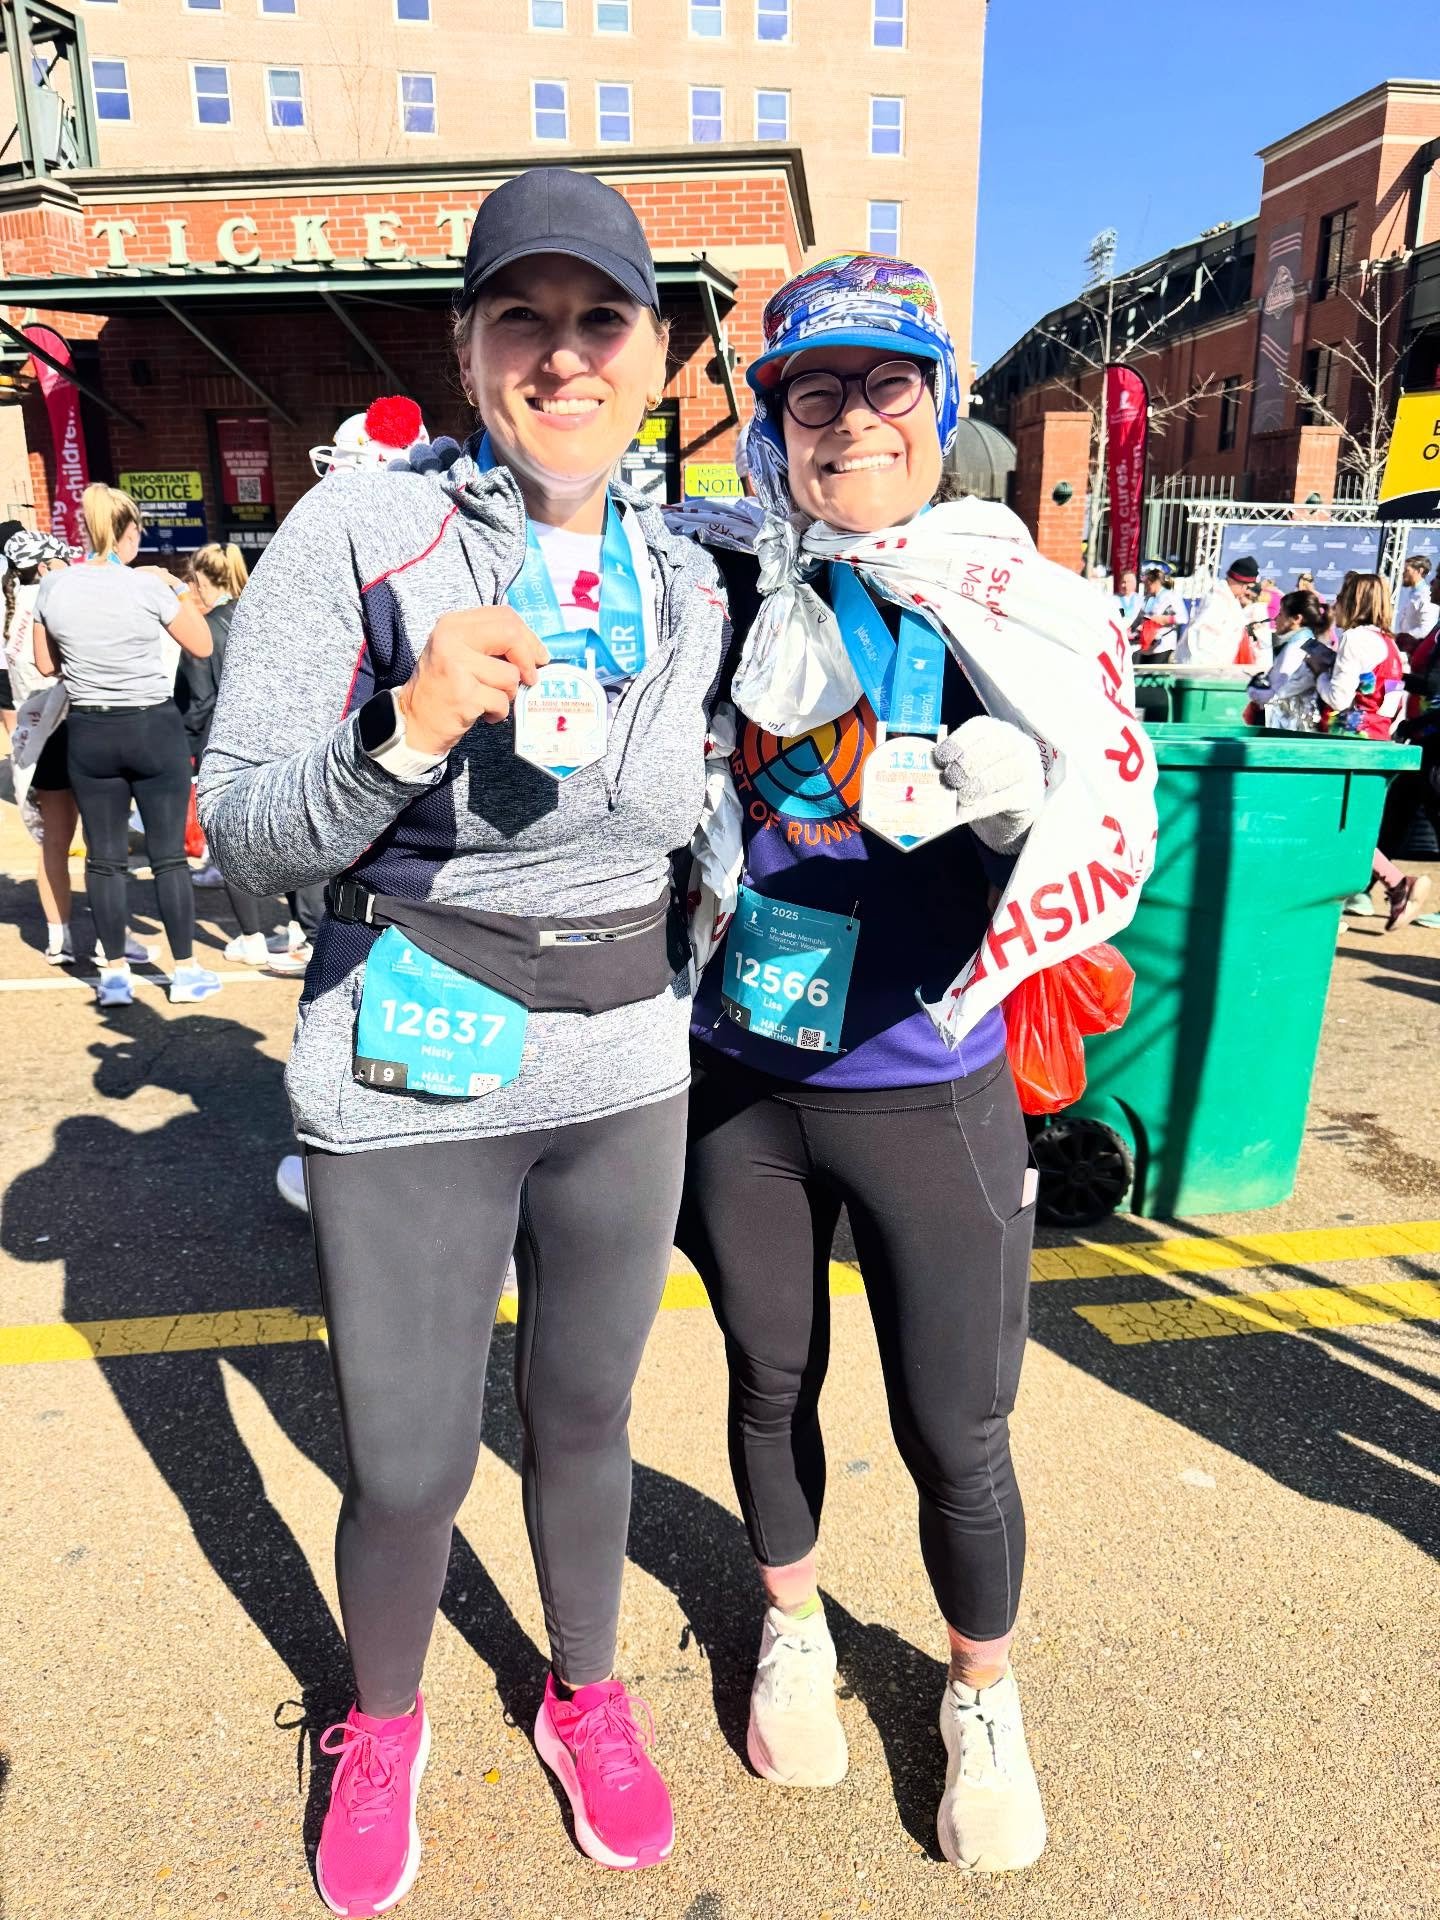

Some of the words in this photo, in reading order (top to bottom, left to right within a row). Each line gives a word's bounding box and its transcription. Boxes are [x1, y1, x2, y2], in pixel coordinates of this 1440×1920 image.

[92, 208, 478, 268] TICKET
[129, 474, 190, 484] IMPORTANT
[697, 467, 735, 477] IMPOR
[130, 485, 192, 499] NOTICE
[698, 479, 740, 493] NOTI
[901, 694, 914, 732] emphis
[919, 694, 934, 733] eekend
[787, 812, 862, 847] RUNN
[771, 906, 799, 921] 2025
[769, 926, 778, 934] St.
[780, 929, 797, 939] Jude
[798, 934, 826, 946] Memphis
[769, 934, 798, 946] Marathon
[735, 952, 830, 1007] 12566
[381, 1000, 506, 1047] 12637
[735, 1010, 742, 1022] 2
[761, 1018, 787, 1033] HALF
[752, 1025, 794, 1044] MARATHON
[383, 1067, 395, 1082] 9
